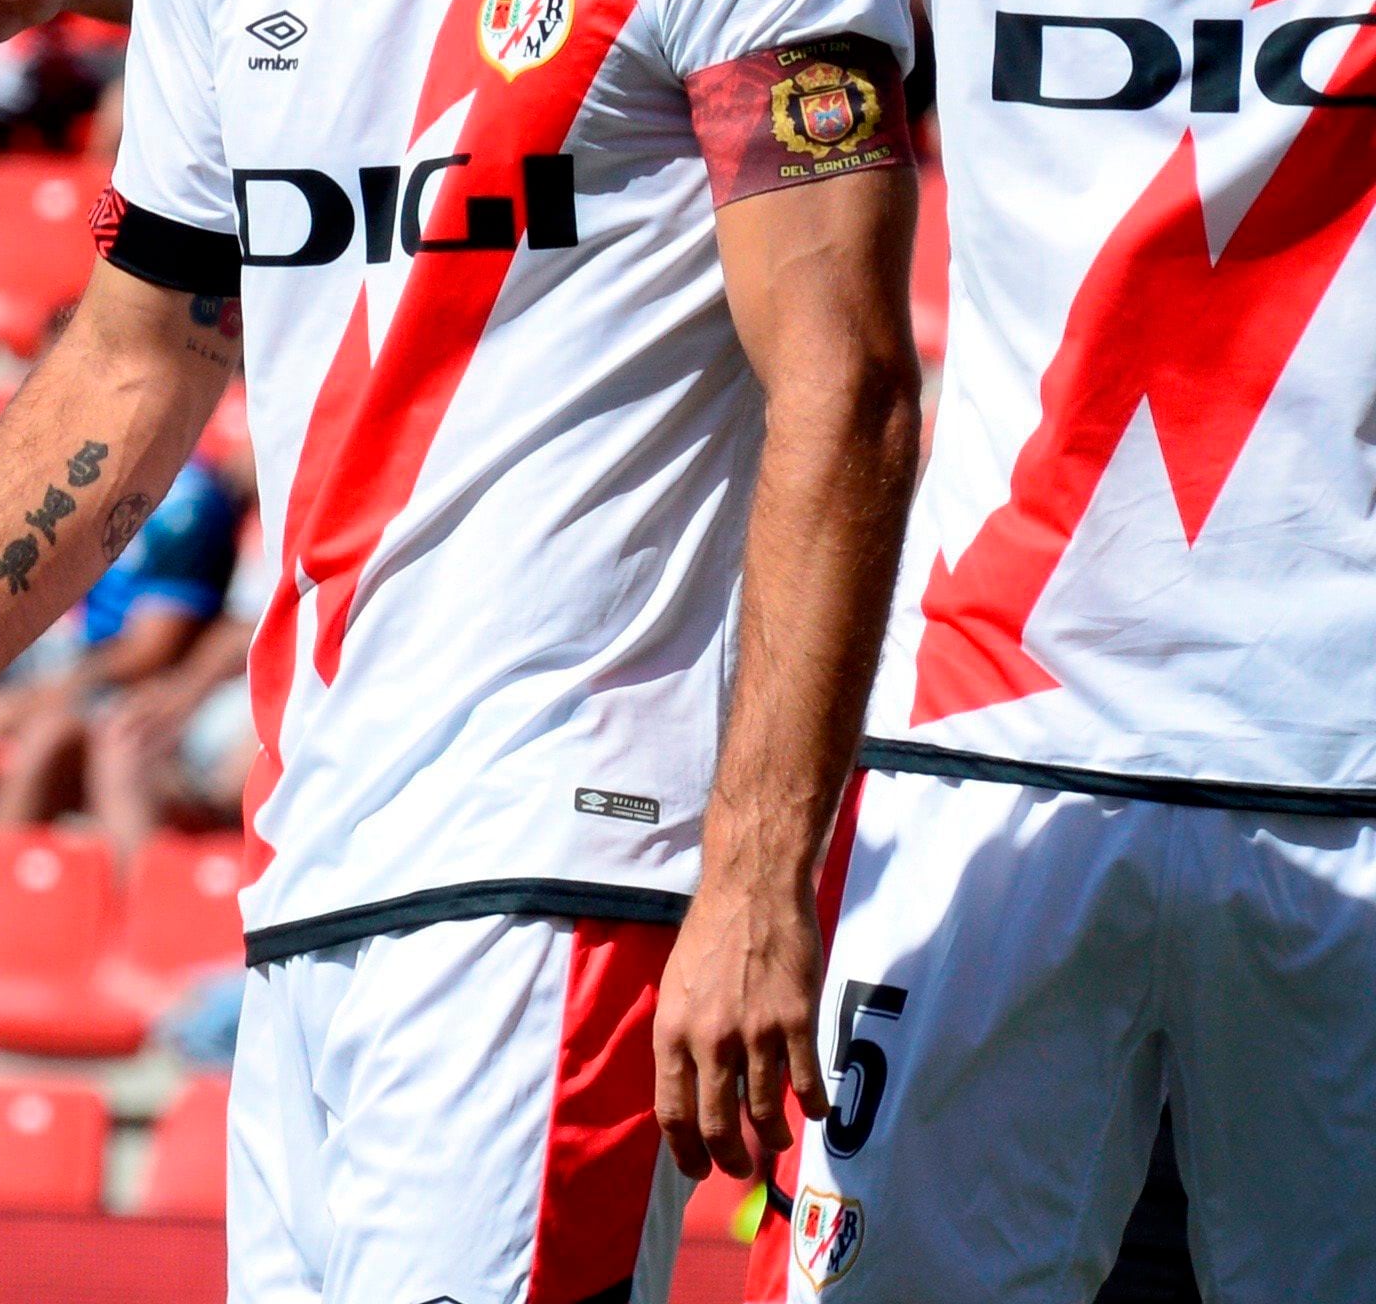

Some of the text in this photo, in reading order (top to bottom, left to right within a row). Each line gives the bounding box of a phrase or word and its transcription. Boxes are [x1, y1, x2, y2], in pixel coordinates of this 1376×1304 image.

[992, 10, 1376, 114] DIG
[232, 152, 579, 267] DIGI
[780, 146, 891, 178] DEL SANTA INES
[612, 796, 655, 811] OFFICIAL
[821, 978, 909, 1161] 5
